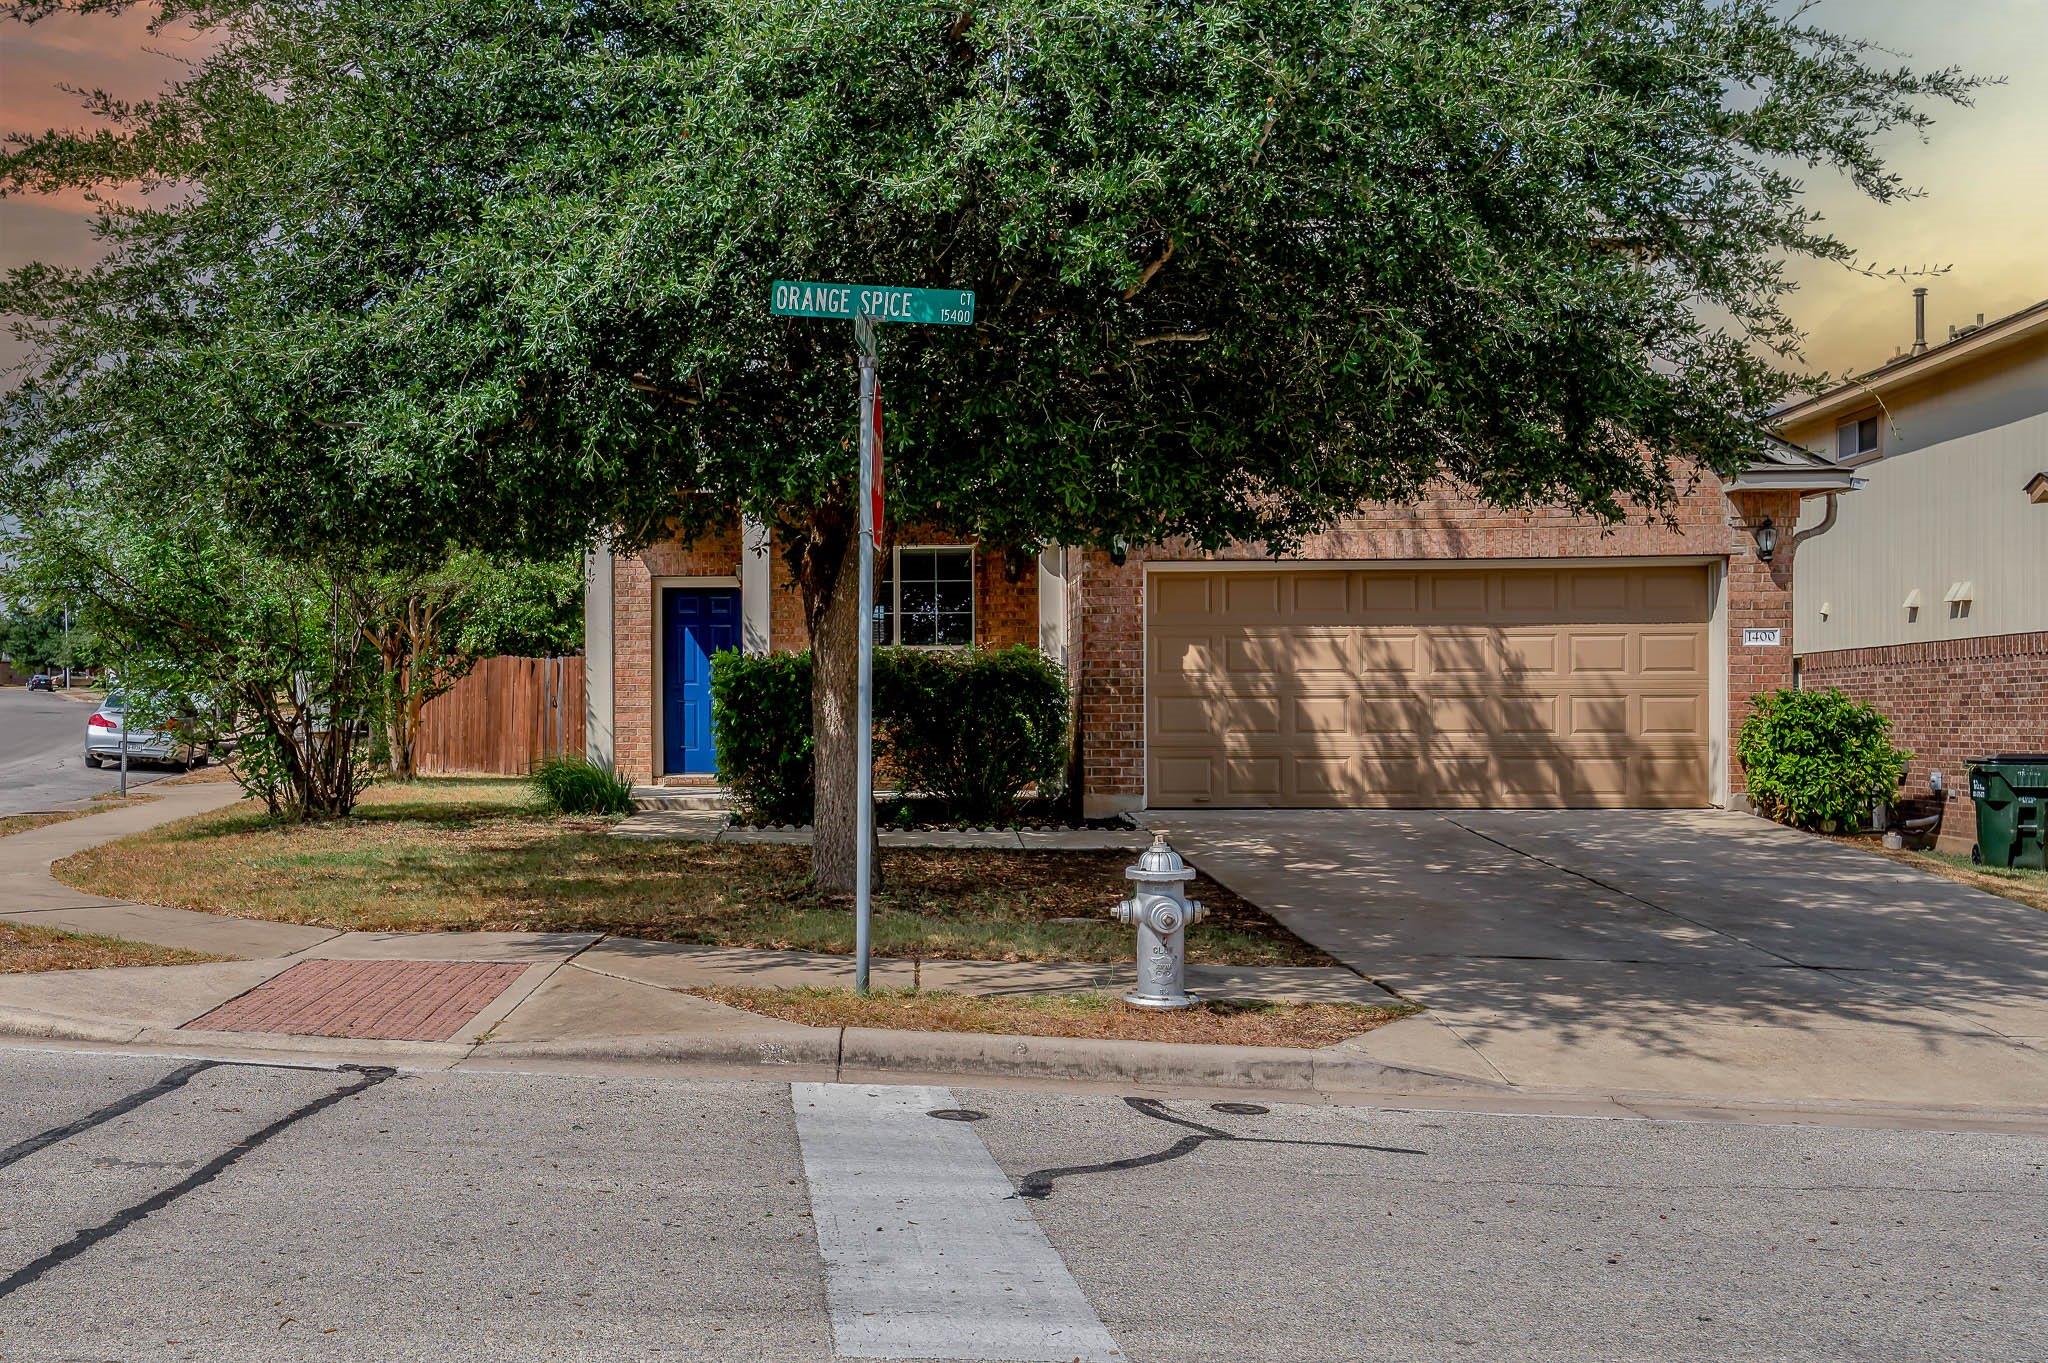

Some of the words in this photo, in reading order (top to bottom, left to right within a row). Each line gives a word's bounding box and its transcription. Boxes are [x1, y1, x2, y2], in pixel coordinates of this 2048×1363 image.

[776, 285, 851, 313] ORANGE
[860, 290, 913, 317] SPICE
[960, 293, 972, 306] CT
[940, 309, 970, 323] 15400
[1747, 631, 1776, 643] 1400
